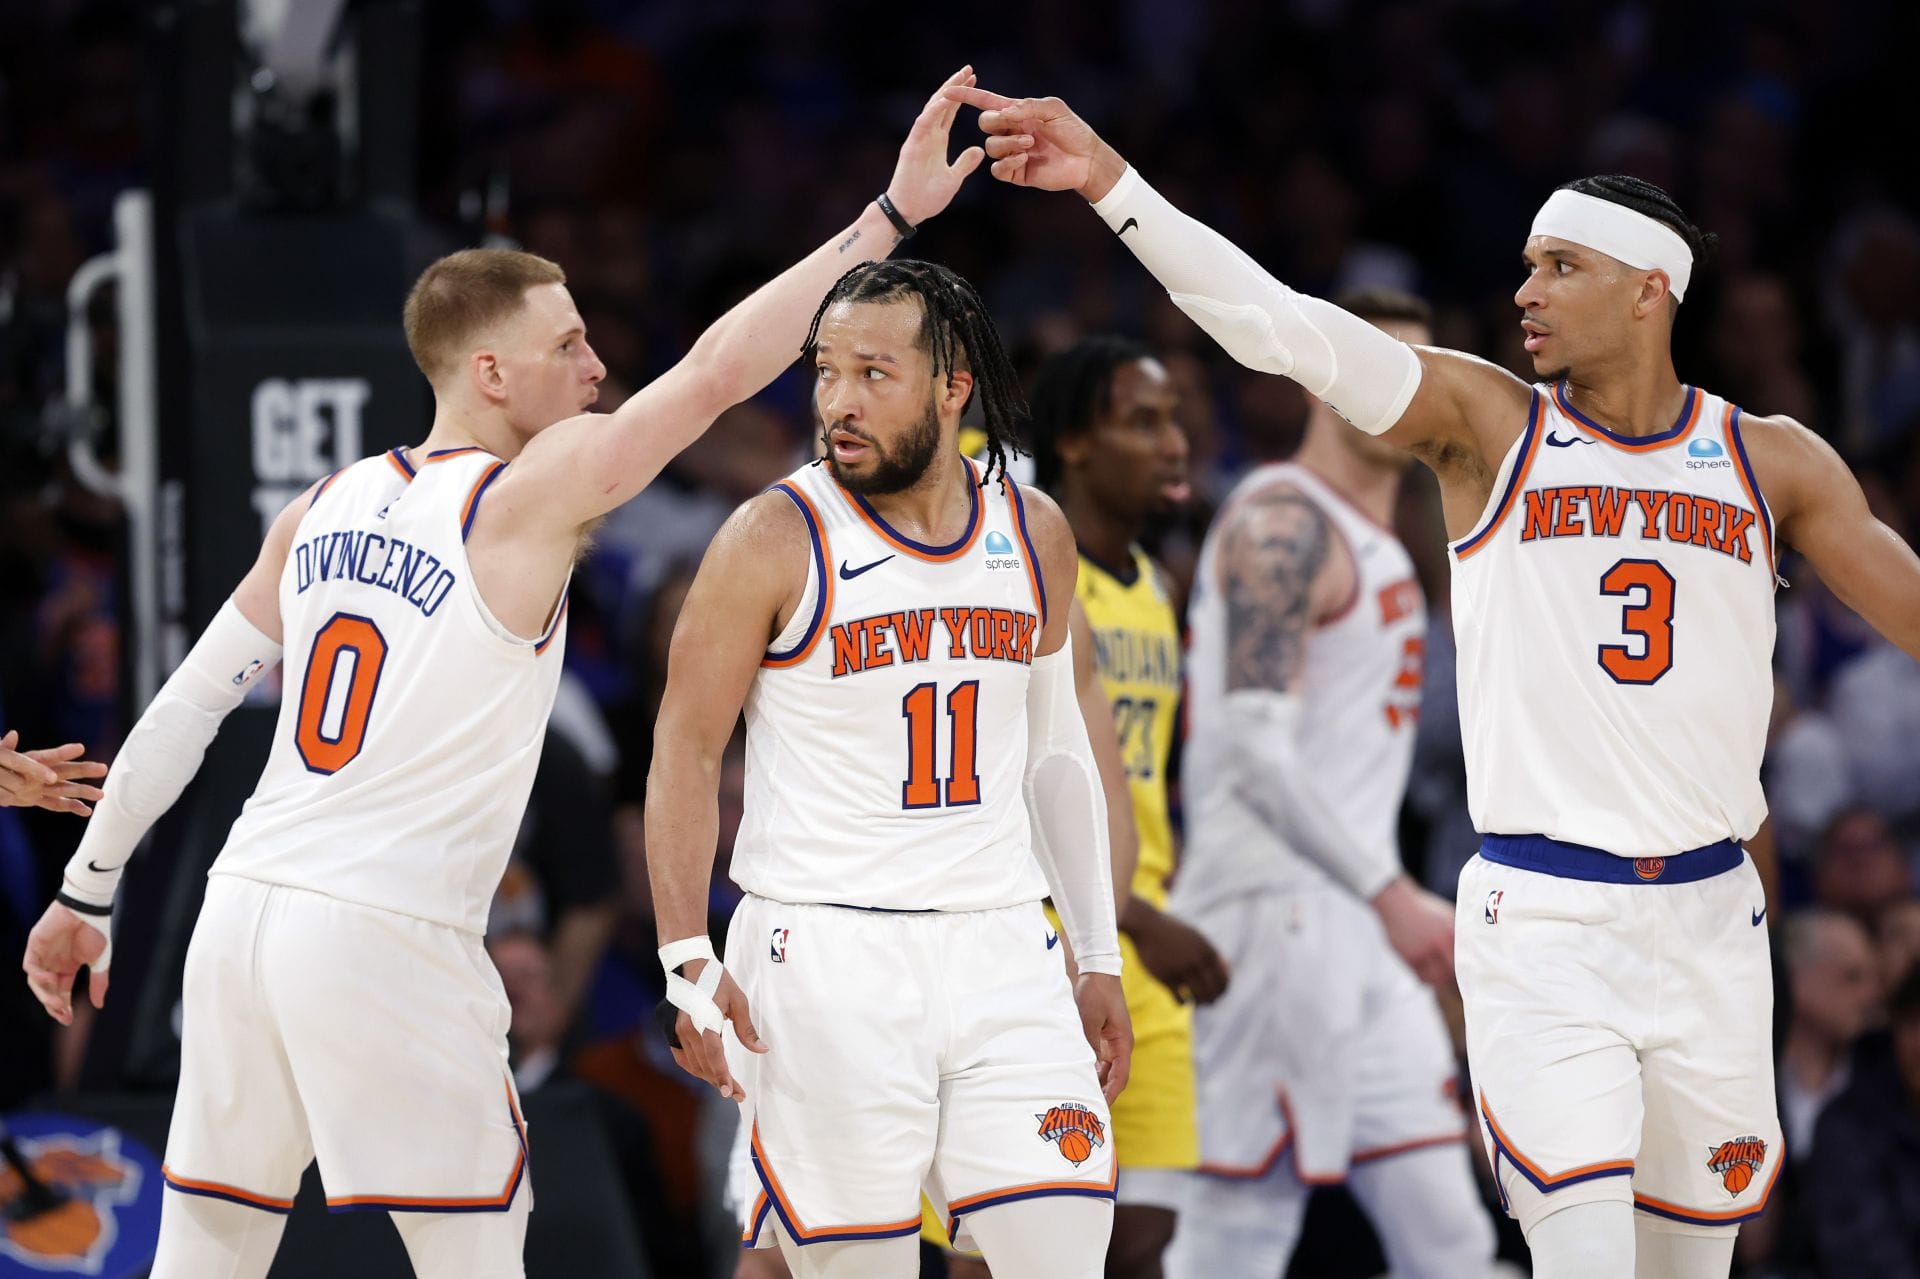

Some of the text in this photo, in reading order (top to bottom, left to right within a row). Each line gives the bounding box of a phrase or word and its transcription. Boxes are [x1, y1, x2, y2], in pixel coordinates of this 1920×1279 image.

[252, 377, 371, 481] GET
[1686, 460, 1731, 471] sphere
[1520, 484, 1756, 566] NEW YORK
[985, 558, 1020, 571] sphere
[829, 606, 1038, 679] NEW YORK
[1598, 558, 1676, 685] 3
[295, 611, 389, 776] 0
[1091, 628, 1183, 690] NDIAN
[902, 680, 981, 809] 11
[1038, 1106, 1105, 1145] KNICKS
[1706, 1139, 1765, 1169] KNICKS
